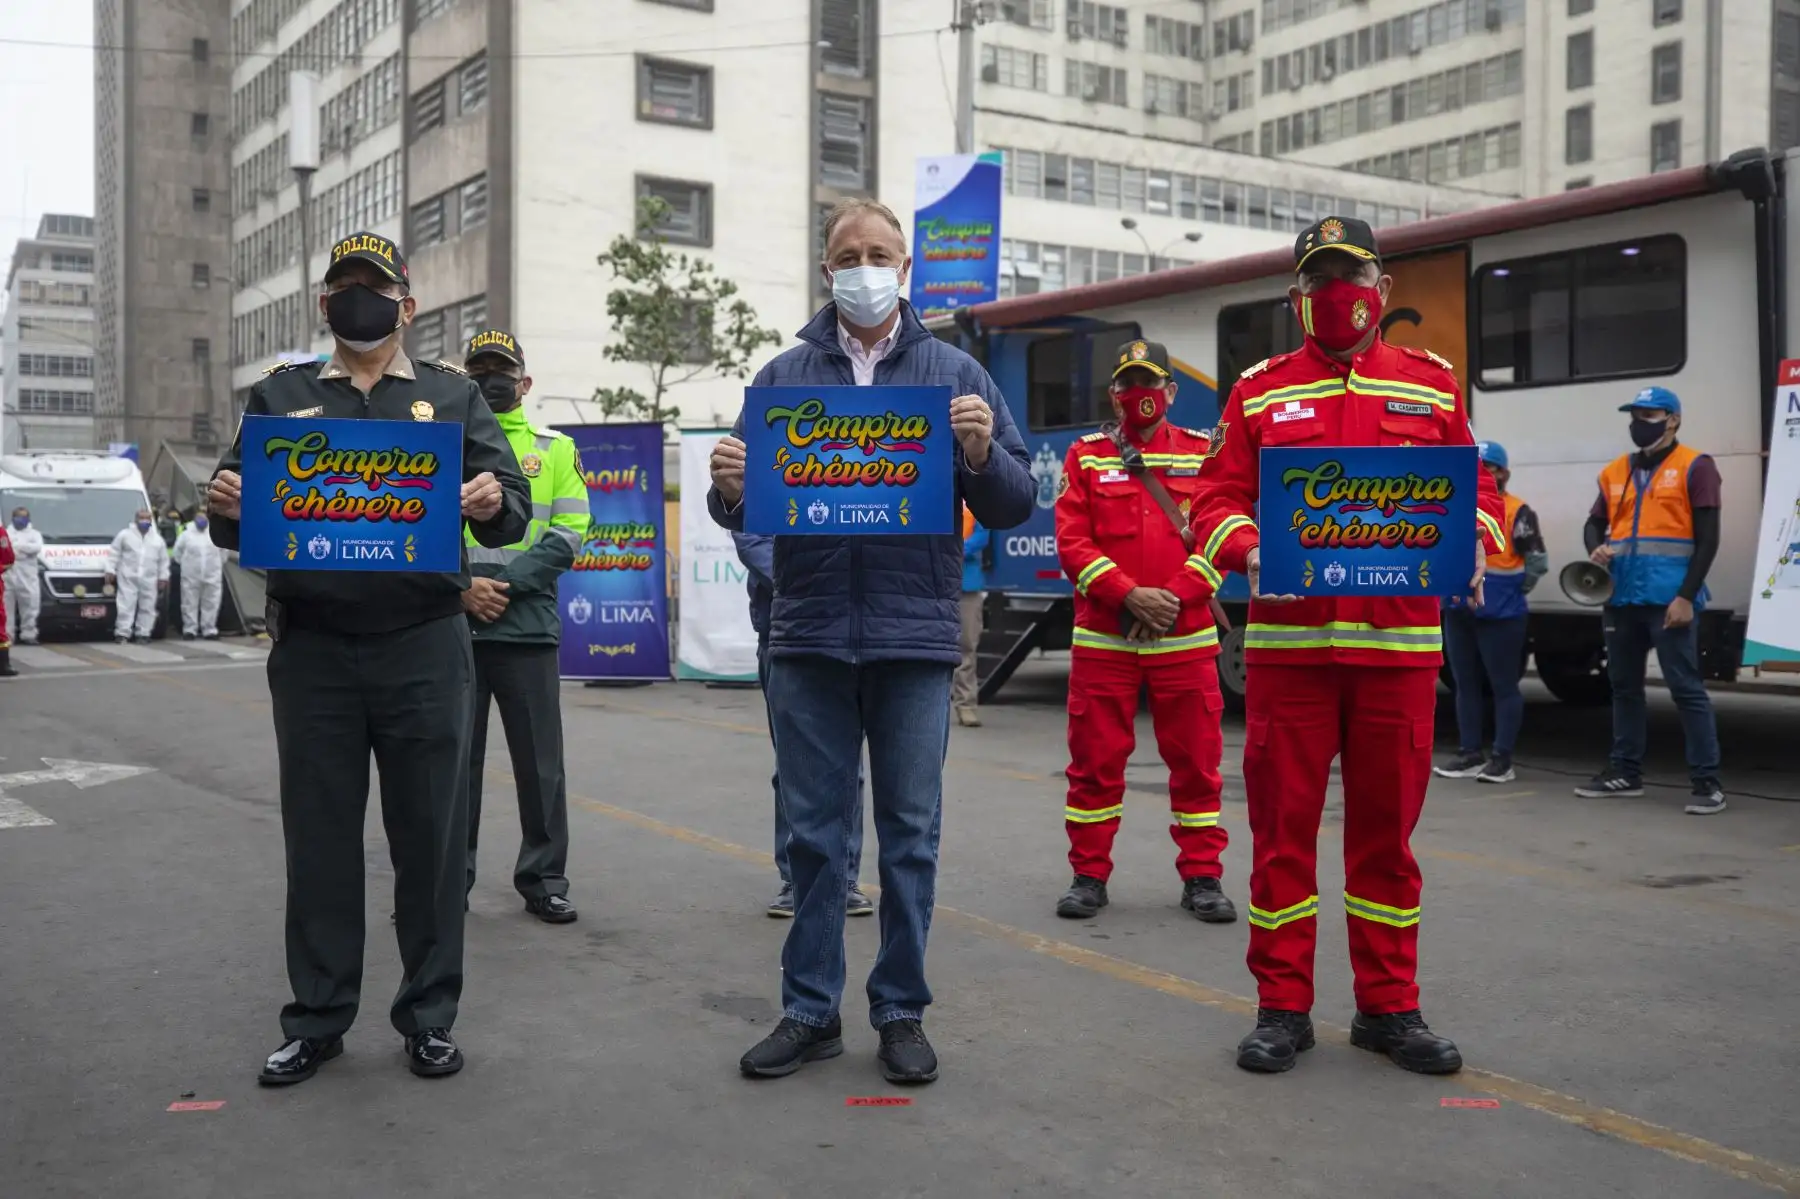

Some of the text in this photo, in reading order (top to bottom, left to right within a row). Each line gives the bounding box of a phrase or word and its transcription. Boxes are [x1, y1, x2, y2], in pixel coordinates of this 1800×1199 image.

[333, 235, 394, 264] POLICIA
[471, 330, 515, 352] POLICIA
[765, 398, 932, 449] Compra
[264, 431, 440, 483] Compra
[783, 453, 920, 488] chévere
[584, 464, 639, 493] AQUÍ
[1281, 460, 1455, 511] Compra
[282, 486, 426, 523] chévere
[840, 510, 890, 523] LIMA
[583, 520, 657, 545] ompra
[1299, 515, 1441, 549] chévere
[342, 545, 395, 559] LIMA
[1006, 536, 1057, 556] CONE
[693, 560, 748, 583] LIM
[1357, 572, 1409, 585] LIMA
[601, 607, 655, 623] LIMA
